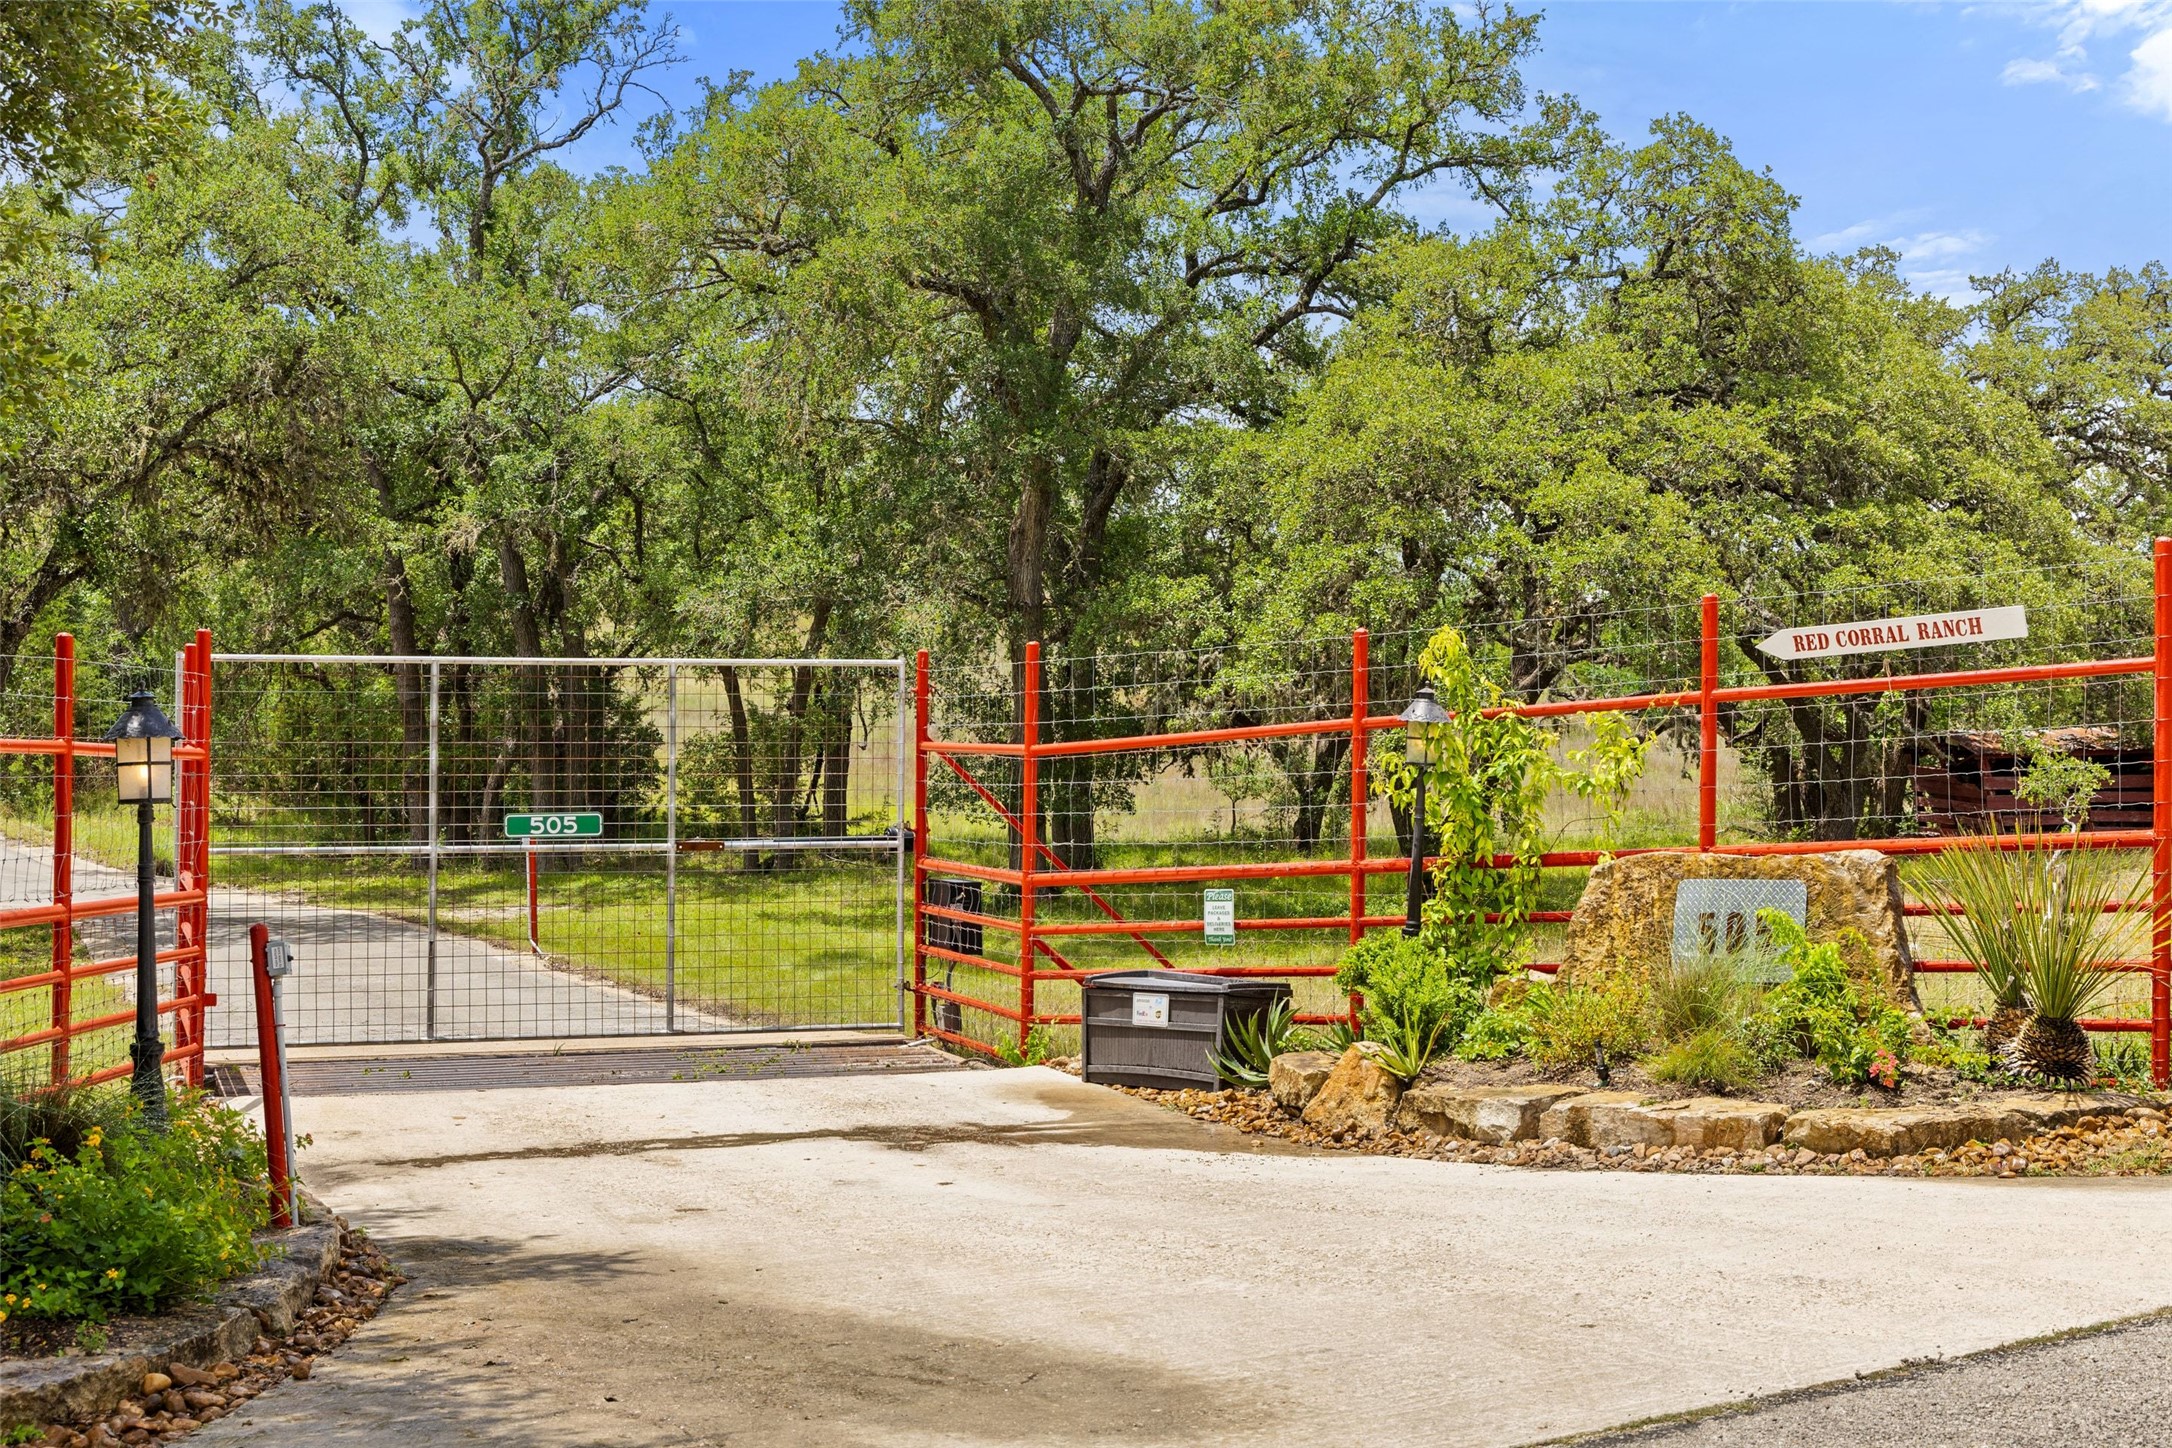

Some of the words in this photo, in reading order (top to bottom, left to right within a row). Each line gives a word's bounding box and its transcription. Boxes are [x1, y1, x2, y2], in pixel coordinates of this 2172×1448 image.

[1792, 632, 1830, 652] RED
[1835, 624, 1910, 648] CORRAL
[1916, 617, 1984, 641] RANCH
[530, 816, 578, 834] 505
[1206, 891, 1232, 901] Please
